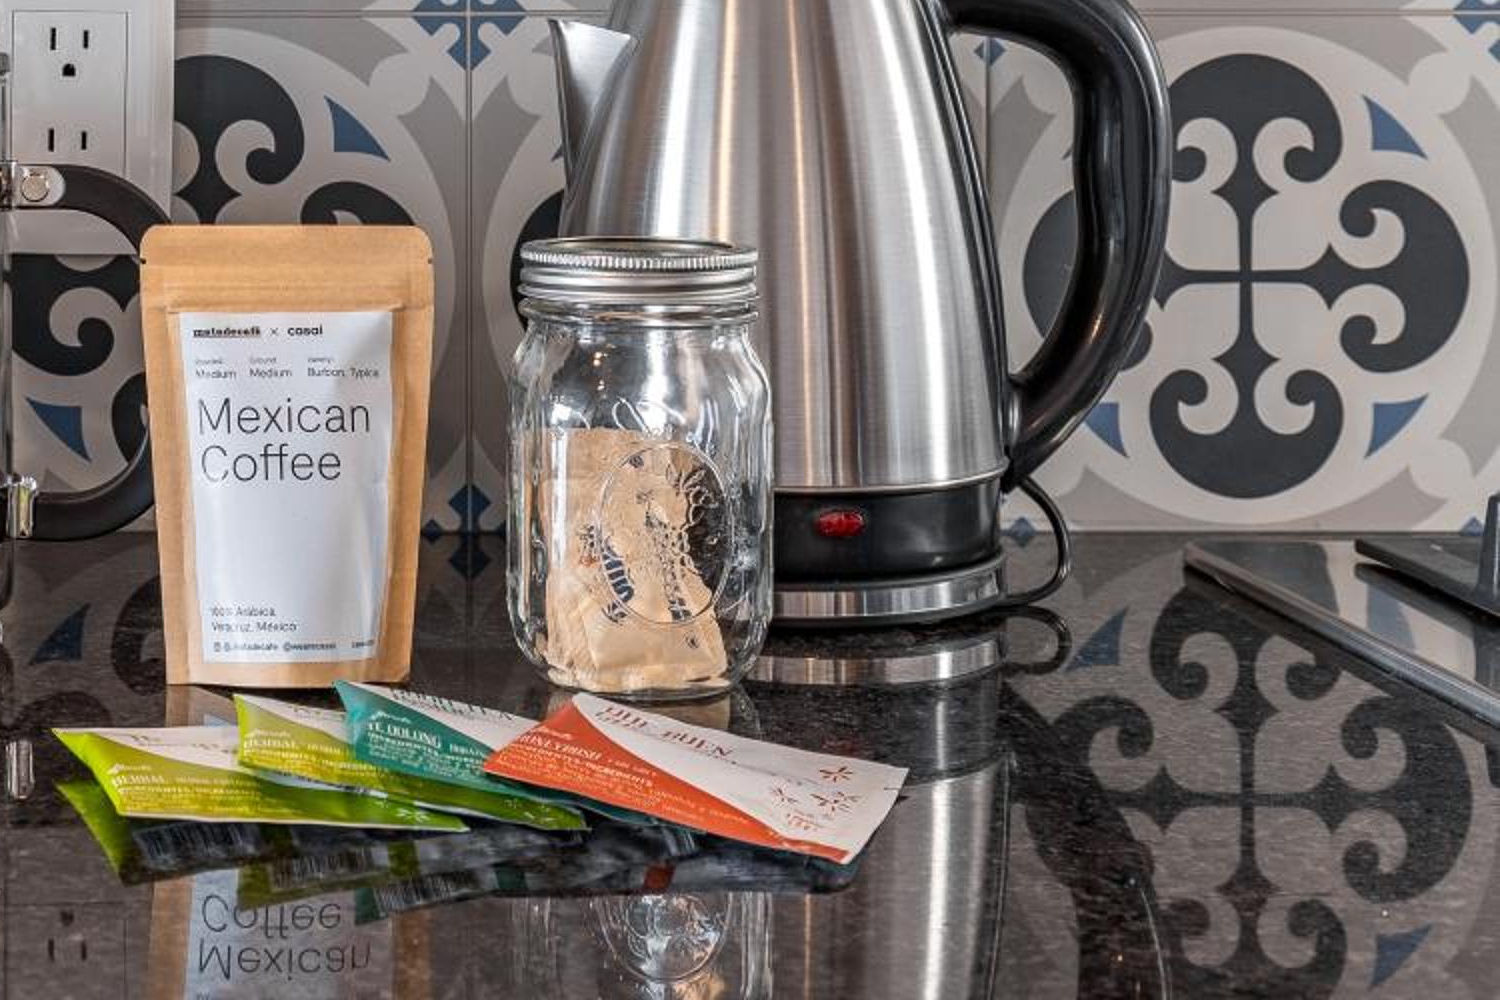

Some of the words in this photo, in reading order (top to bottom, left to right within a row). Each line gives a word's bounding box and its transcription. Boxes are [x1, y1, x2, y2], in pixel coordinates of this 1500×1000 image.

[287, 323, 323, 337] casai
[195, 369, 237, 379] Medium
[250, 367, 292, 378] Medium
[198, 397, 371, 435] Mexican
[200, 444, 342, 483] Coffee
